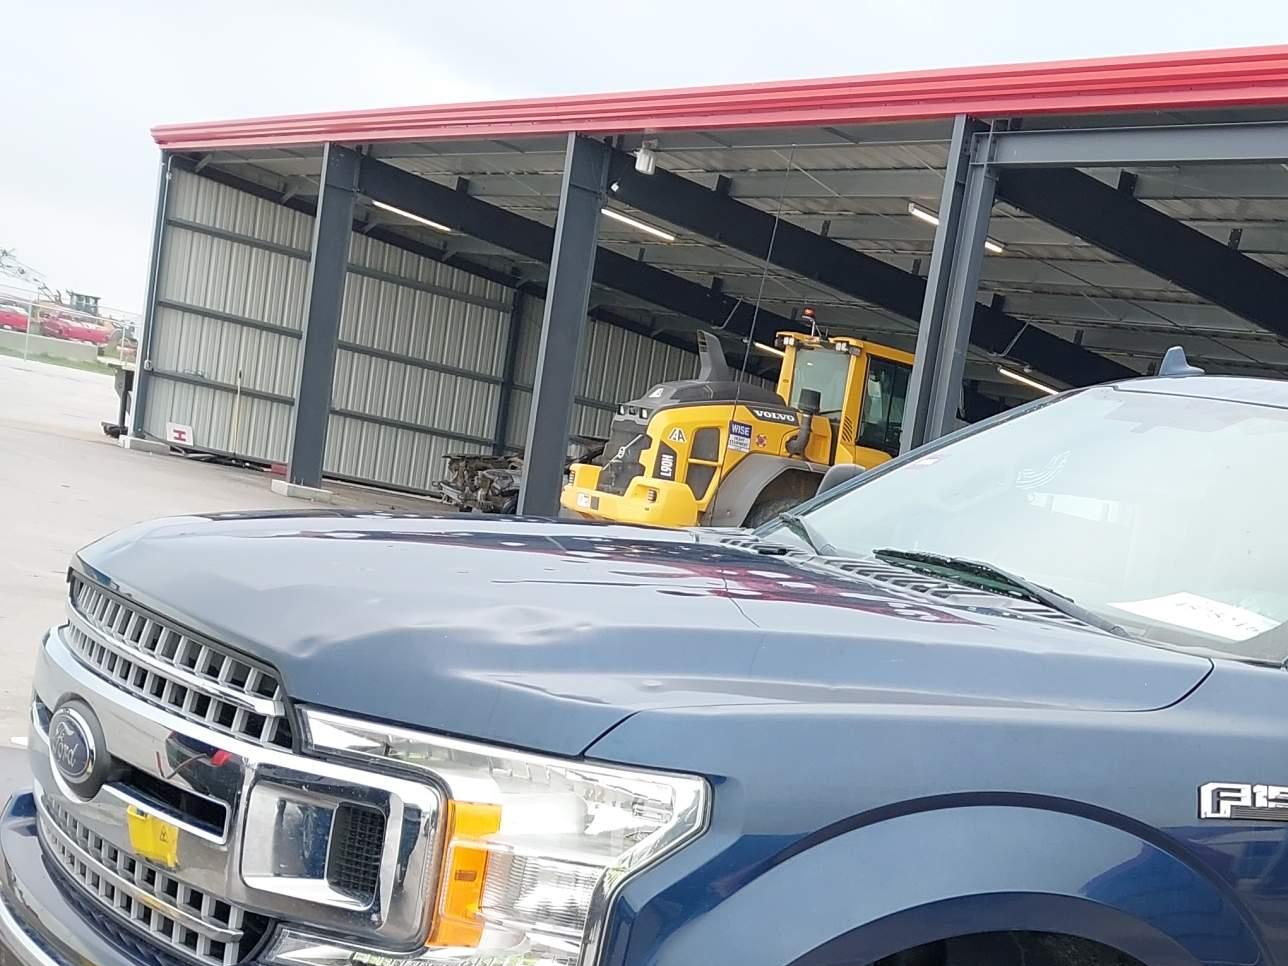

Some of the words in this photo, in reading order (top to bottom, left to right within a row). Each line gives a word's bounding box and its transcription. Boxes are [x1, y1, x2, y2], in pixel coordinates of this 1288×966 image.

[753, 409, 795, 421] VOLVO
[731, 423, 750, 436] WISE
[660, 454, 674, 477] L90H
[54, 721, 78, 768] Ford
